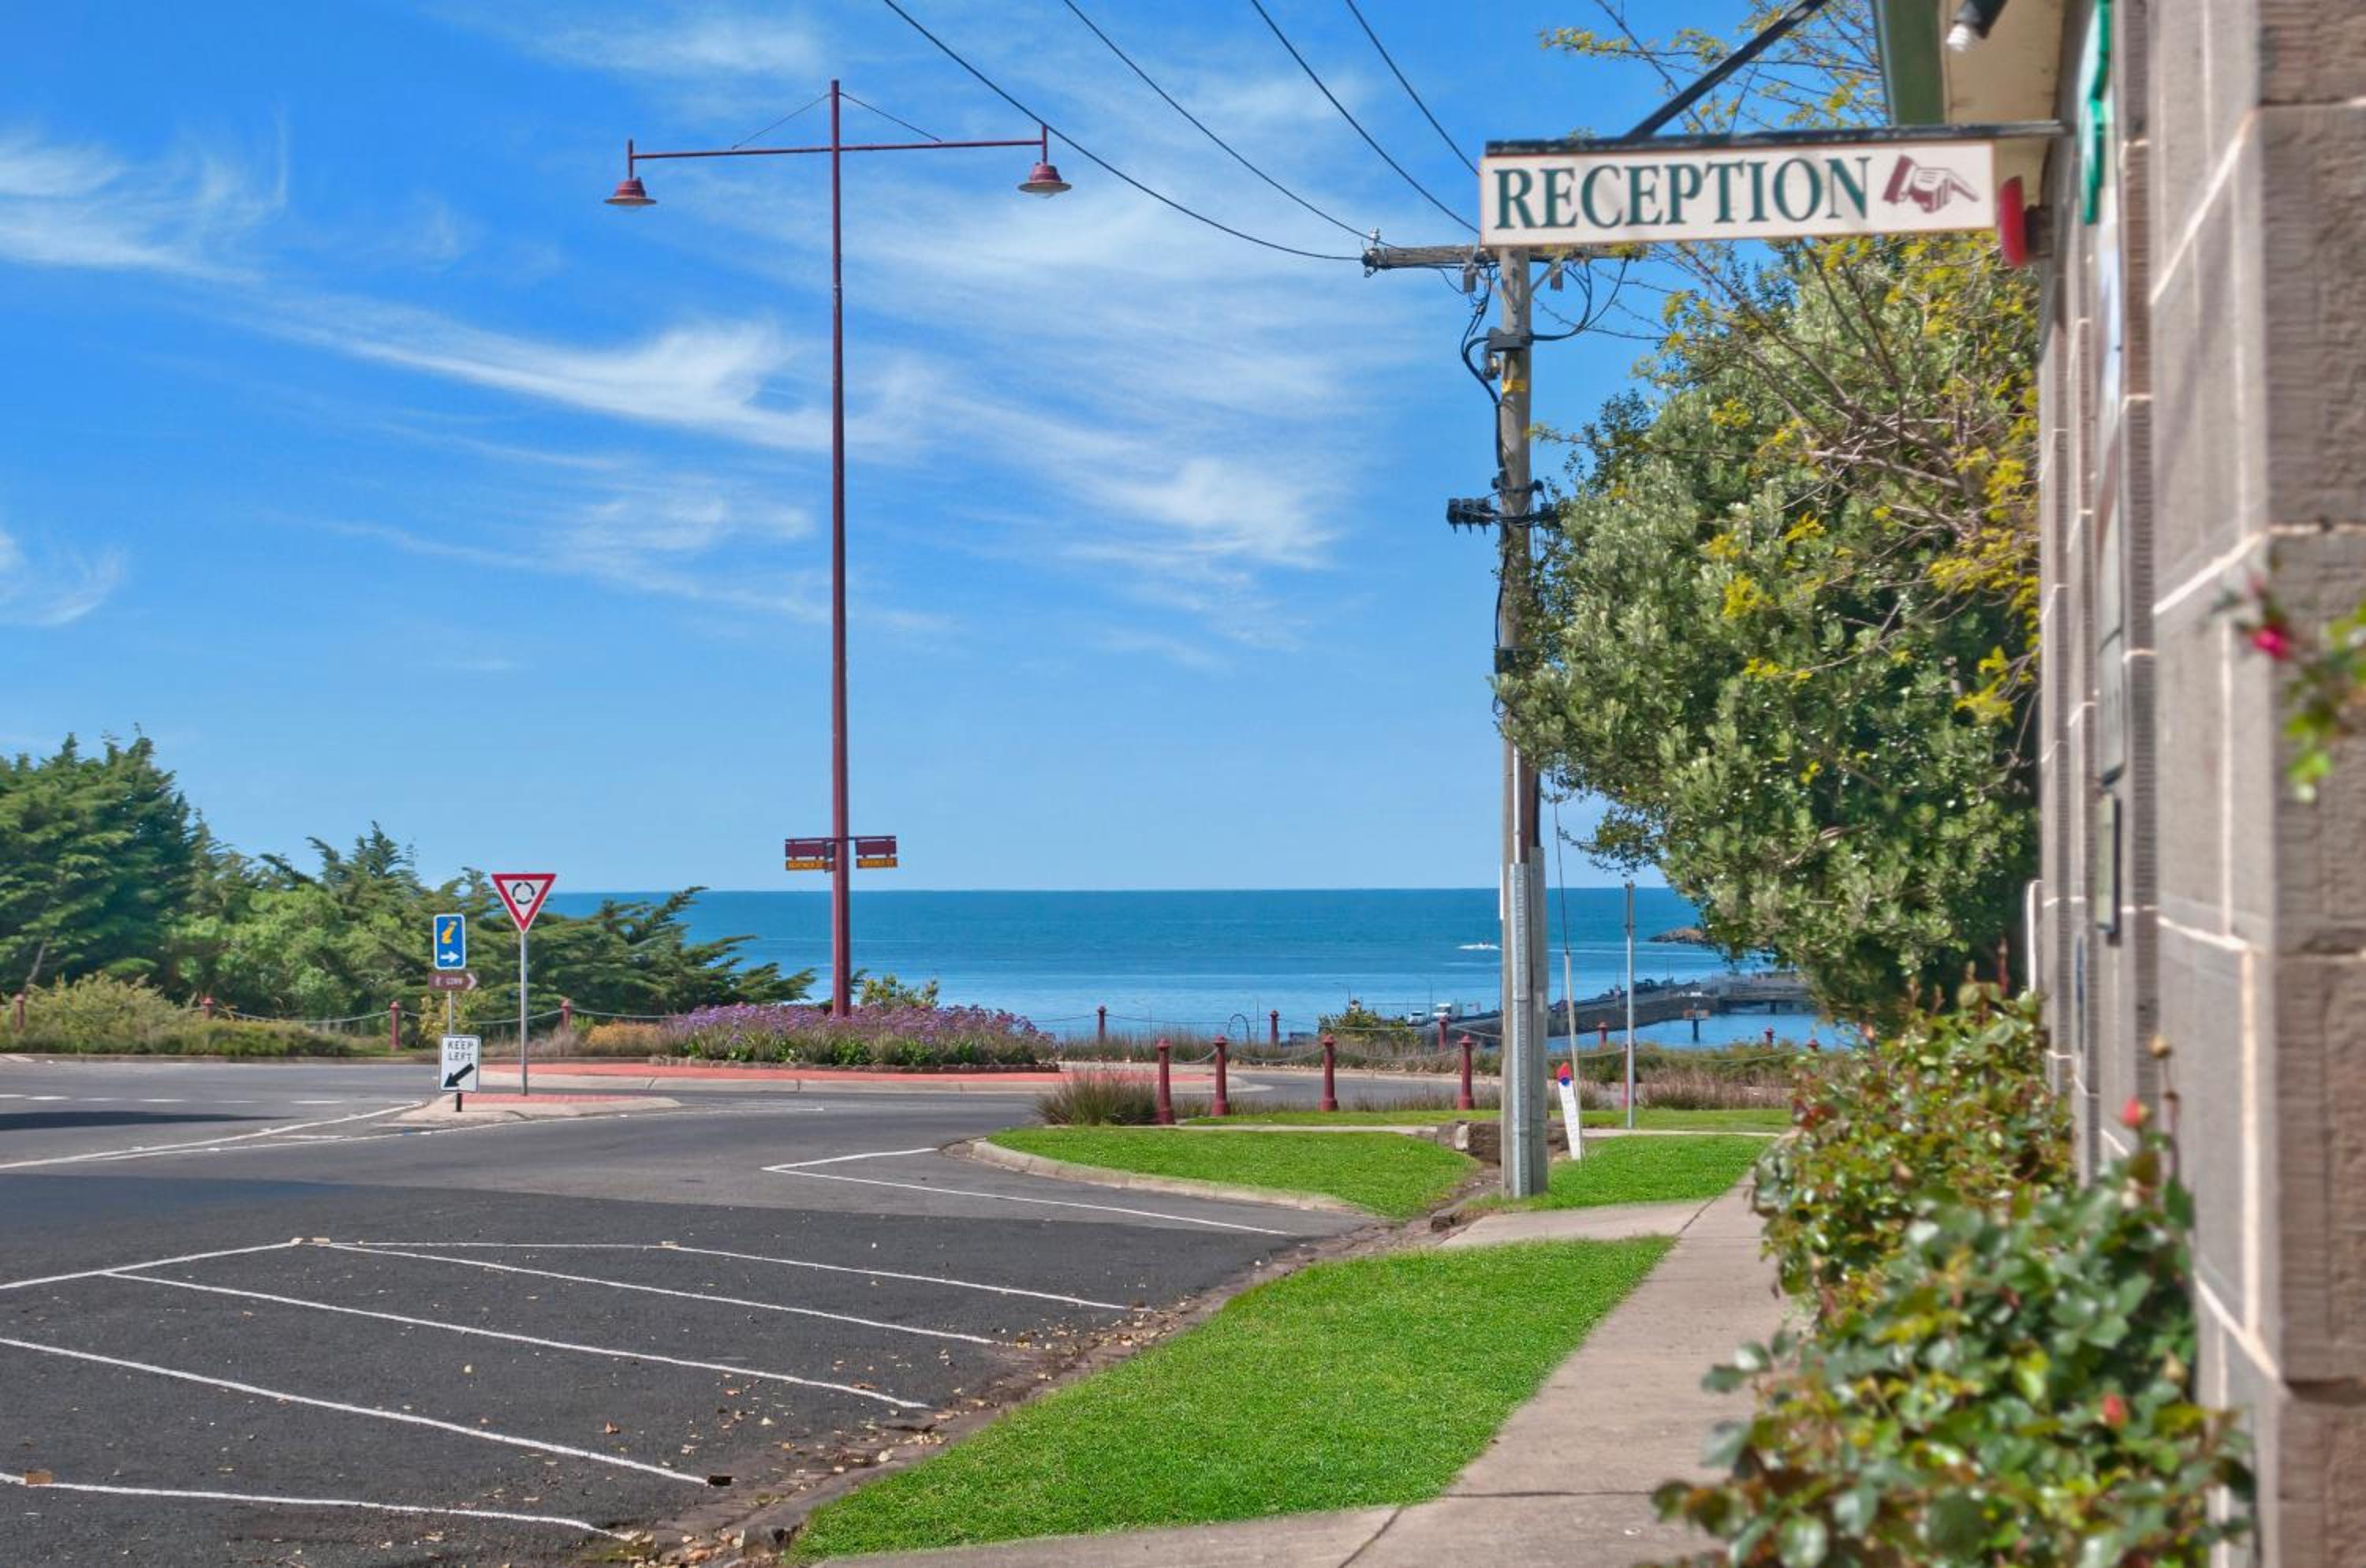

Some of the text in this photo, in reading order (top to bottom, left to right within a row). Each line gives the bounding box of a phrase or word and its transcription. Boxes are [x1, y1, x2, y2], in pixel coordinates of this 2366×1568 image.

[1493, 156, 1872, 230] RECEPTION
[447, 1040, 474, 1051] KEEP
[447, 1051, 474, 1062] LEFT
